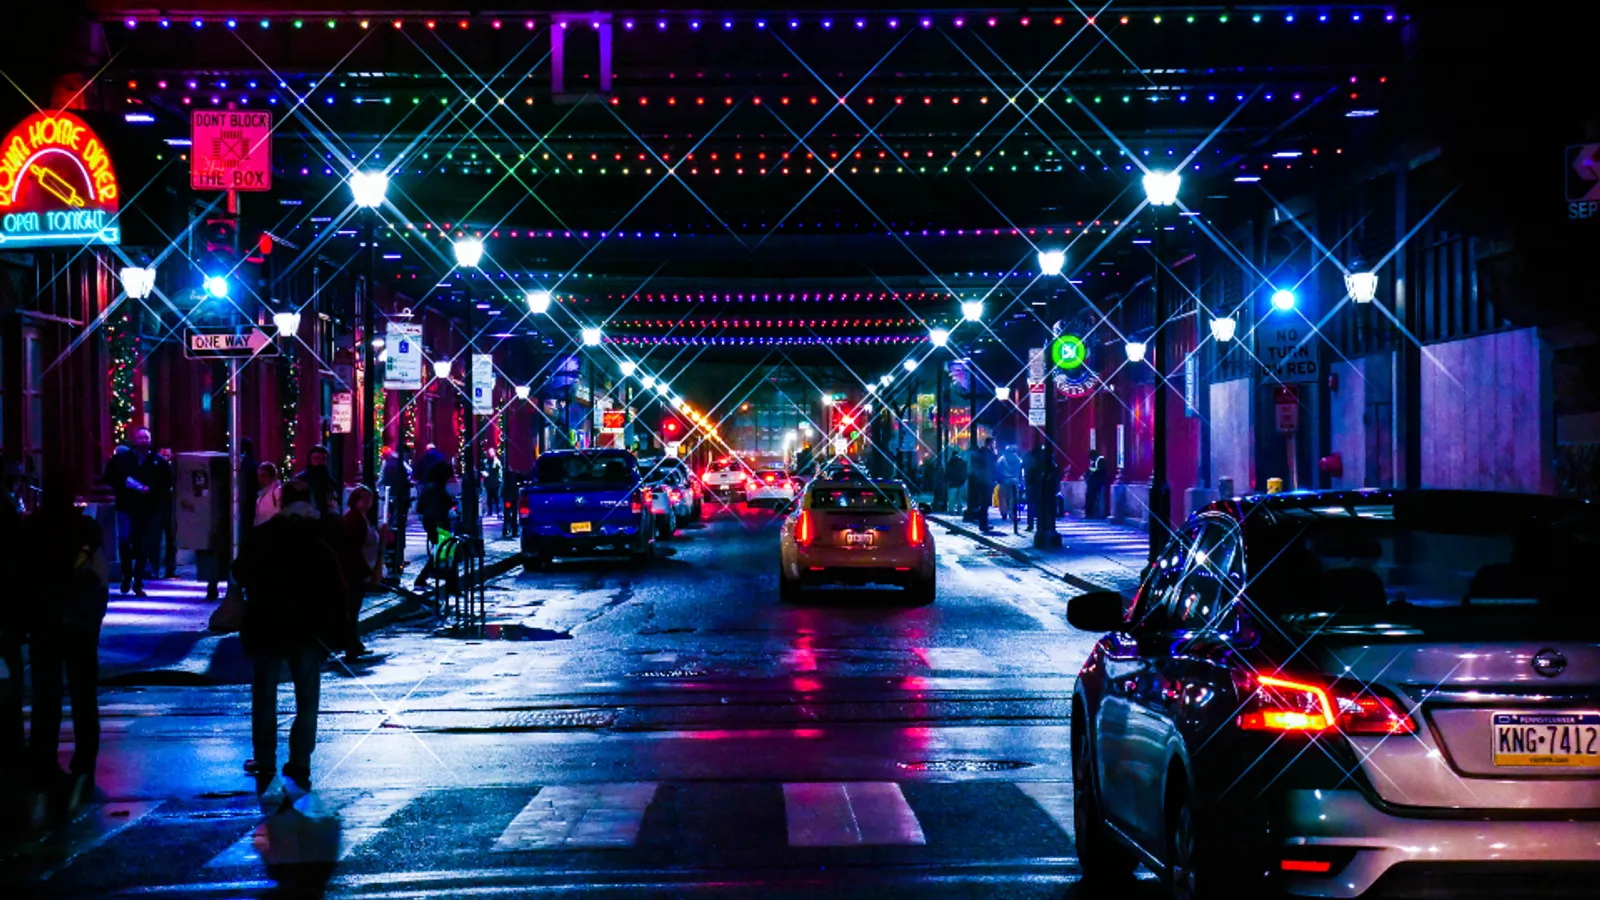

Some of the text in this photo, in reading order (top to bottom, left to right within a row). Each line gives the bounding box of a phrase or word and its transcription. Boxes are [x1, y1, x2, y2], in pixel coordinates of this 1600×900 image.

[230, 113, 267, 128] BLOCK
[28, 118, 86, 151] HOME
[83, 138, 117, 203] DINER
[197, 170, 264, 187] THE BOX
[3, 209, 106, 232] OPEN TONIGHT
[196, 335, 251, 348] ONE WAY
[1276, 329, 1297, 341] NO
[1268, 345, 1309, 359] TURN
[1263, 361, 1317, 377] ON RED
